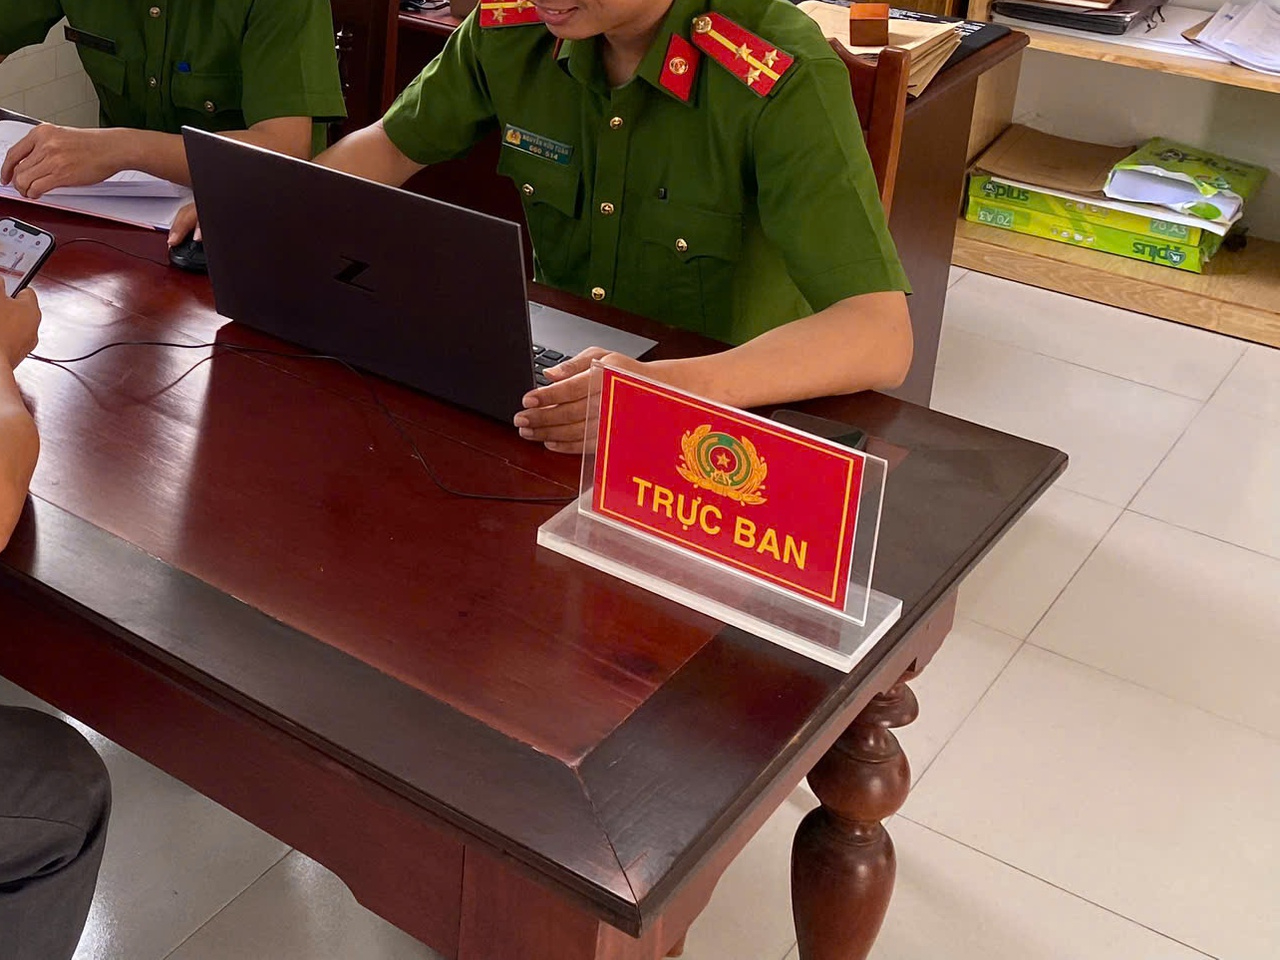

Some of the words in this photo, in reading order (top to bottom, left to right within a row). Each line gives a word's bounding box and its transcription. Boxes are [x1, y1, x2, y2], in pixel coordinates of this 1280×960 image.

[979, 211, 994, 221] A3
[997, 214, 1010, 225] 70
[1152, 221, 1166, 230] 70
[1169, 225, 1187, 234] A3
[1133, 242, 1170, 261] plus
[632, 476, 723, 530] TRỰC
[733, 516, 808, 570] BAN
